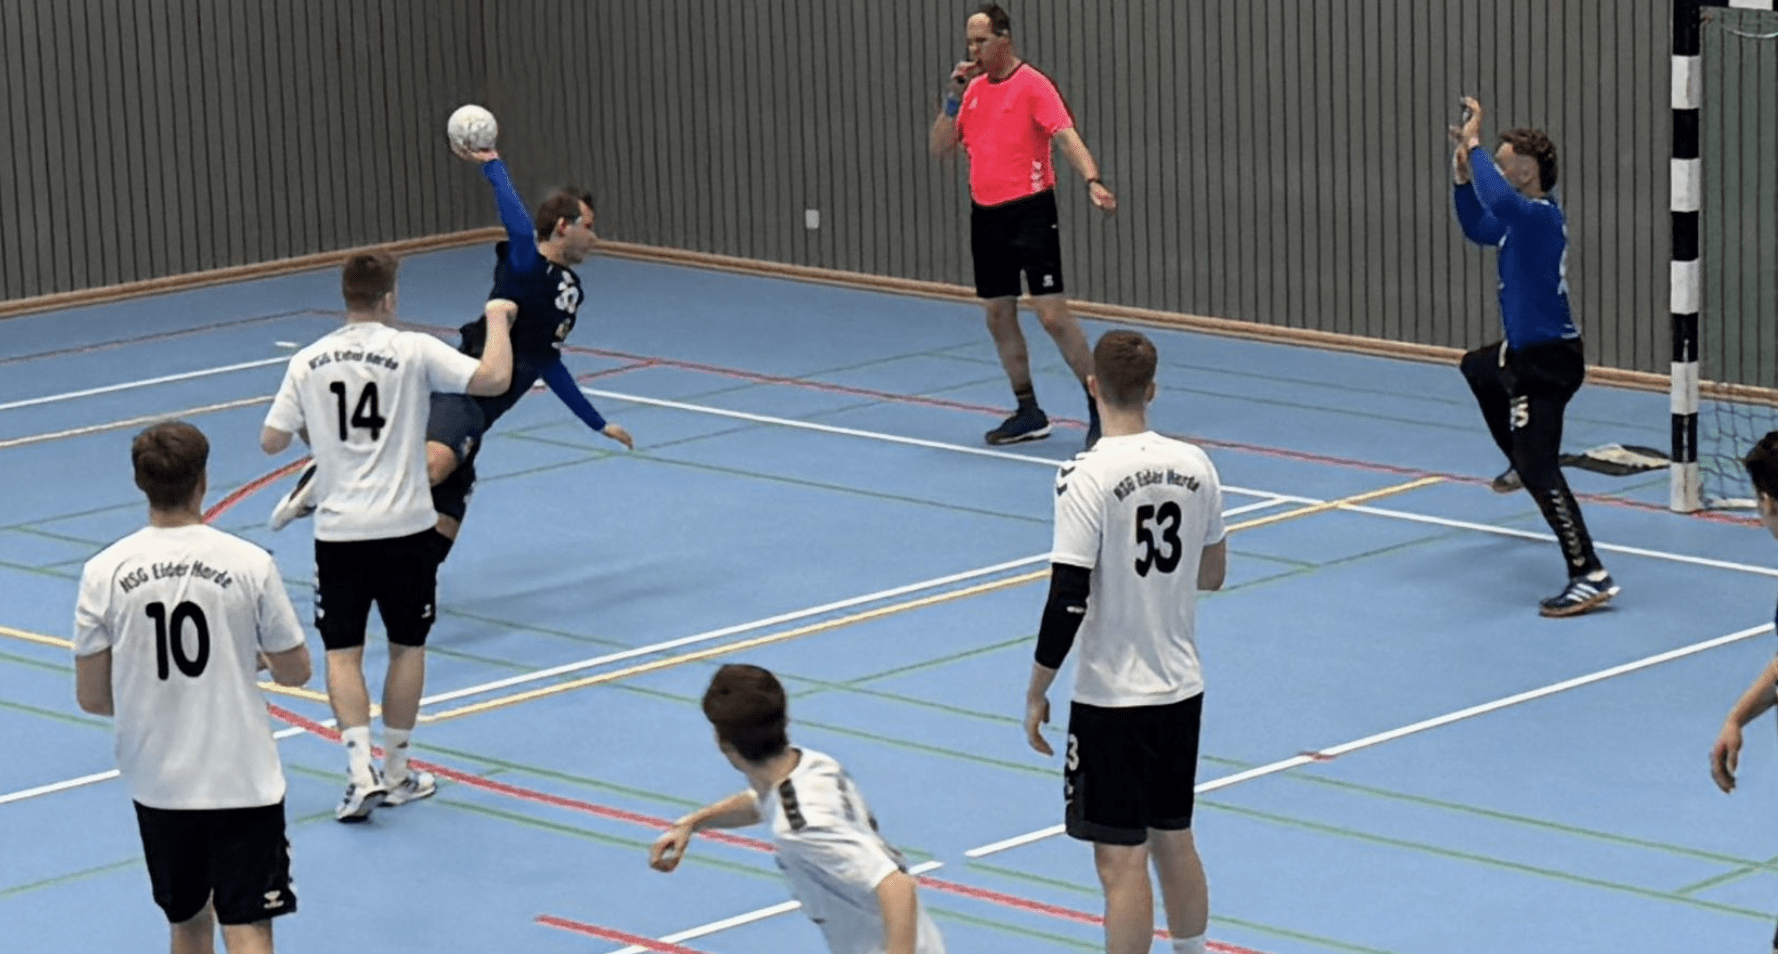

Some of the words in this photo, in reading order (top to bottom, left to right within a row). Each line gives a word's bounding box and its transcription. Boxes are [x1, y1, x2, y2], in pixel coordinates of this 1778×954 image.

[329, 381, 386, 442] 14
[1135, 501, 1182, 577] 53
[145, 601, 210, 681] 10
